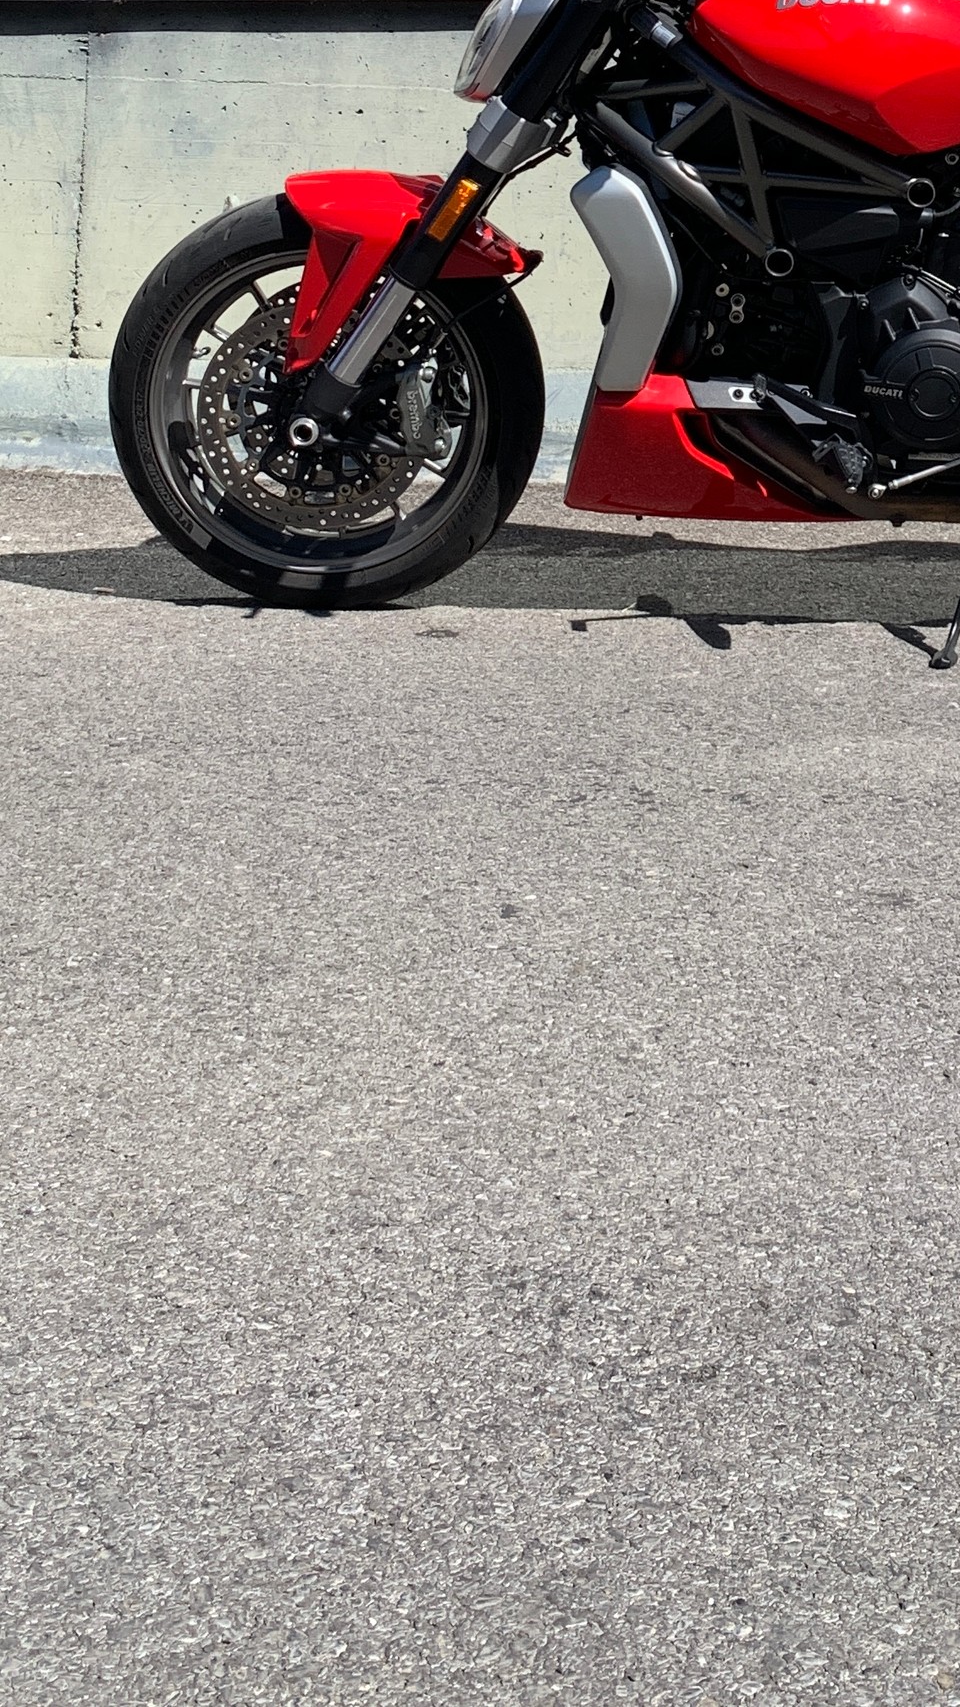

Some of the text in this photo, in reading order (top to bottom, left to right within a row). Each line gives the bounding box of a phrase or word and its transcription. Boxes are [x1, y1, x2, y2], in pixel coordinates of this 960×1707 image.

[407, 390, 422, 440] brembo
[864, 385, 903, 398] DUCATI
[146, 462, 181, 516] MICHELIN
